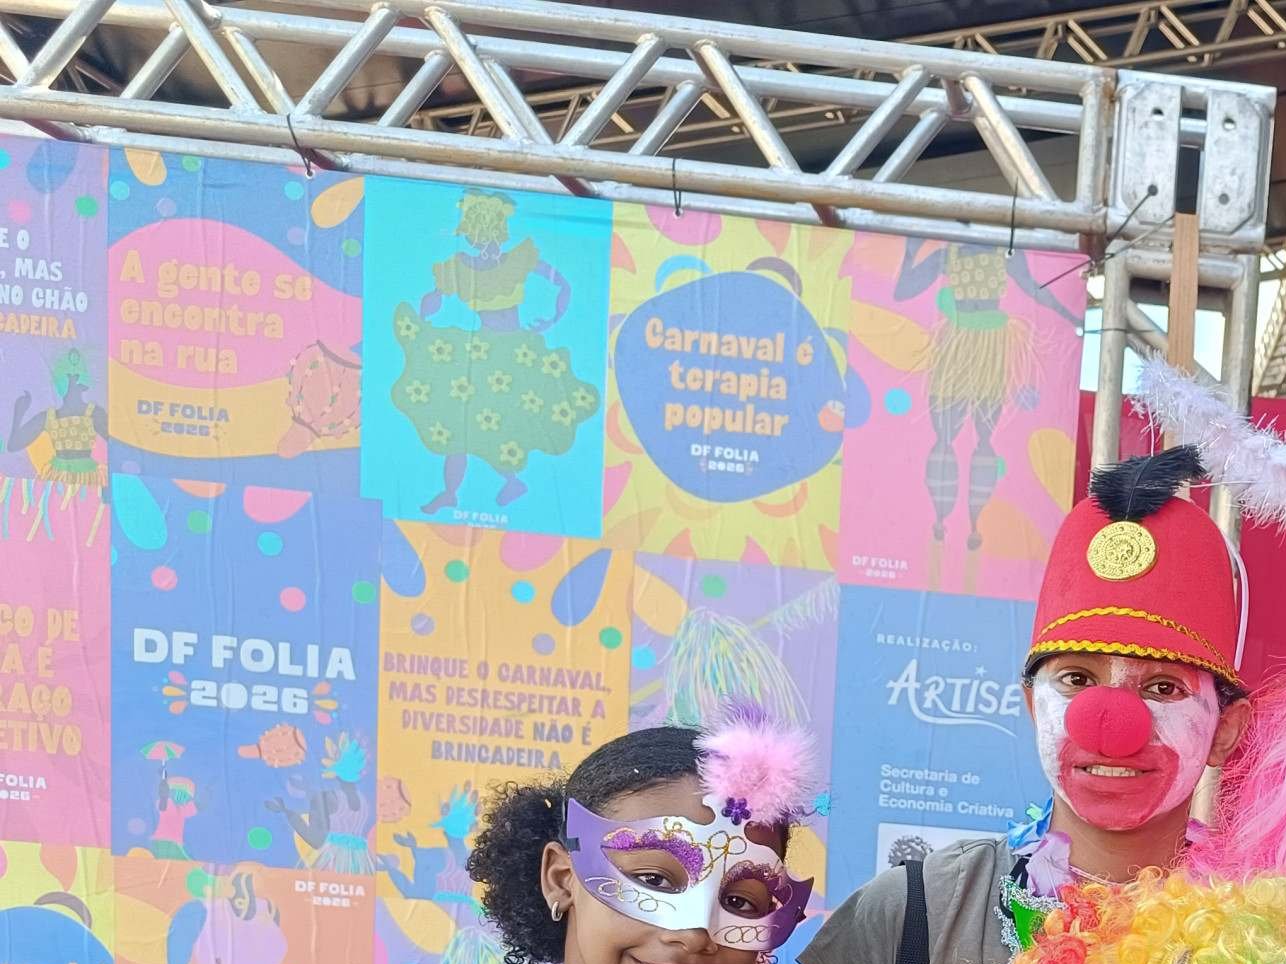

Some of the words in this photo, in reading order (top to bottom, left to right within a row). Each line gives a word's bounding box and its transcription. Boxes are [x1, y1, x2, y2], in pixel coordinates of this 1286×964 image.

[16, 229, 30, 250] O
[14, 257, 63, 281] MAS
[120, 249, 145, 283] A
[157, 258, 261, 298] gente
[273, 274, 313, 300] se
[31, 286, 88, 312] CHÃO
[120, 299, 284, 338] encontra
[120, 339, 163, 367] na
[177, 343, 238, 374] rua
[645, 317, 785, 362] Carnaval
[796, 337, 814, 365] é
[668, 360, 787, 400] terapia
[137, 400, 164, 416] DF
[169, 403, 230, 422] FOLIA
[664, 402, 790, 436] popular
[690, 444, 712, 457] DF
[714, 446, 759, 462] FOLIA
[852, 555, 869, 567] DF
[871, 557, 908, 570] FOLIA
[47, 608, 80, 641] DE
[37, 639, 55, 677] É
[133, 628, 198, 664] DF
[212, 635, 356, 680] FOLIA
[876, 632, 978, 652] REALIZAÇÃO:
[383, 651, 468, 678] BRINQUE
[477, 661, 490, 680] O
[497, 662, 613, 693] CARNAVAL,
[0, 682, 73, 721] AÇO
[190, 680, 309, 714] 2026
[389, 681, 437, 704] MAS
[445, 685, 583, 717] DESRESPEITAR
[591, 699, 606, 719] A
[402, 708, 524, 738] DIVERSIDADE
[533, 721, 573, 744] NÃO
[582, 721, 592, 745] É
[431, 740, 561, 769] BRINCADEIRA
[880, 764, 958, 785] Secretaria
[962, 772, 980, 785] de
[880, 780, 935, 796] Cultura
[938, 787, 948, 797] e
[878, 795, 952, 813] Economia
[958, 801, 1014, 819] Criativa
[295, 880, 316, 893] DF
[319, 881, 366, 897] FOLIA
